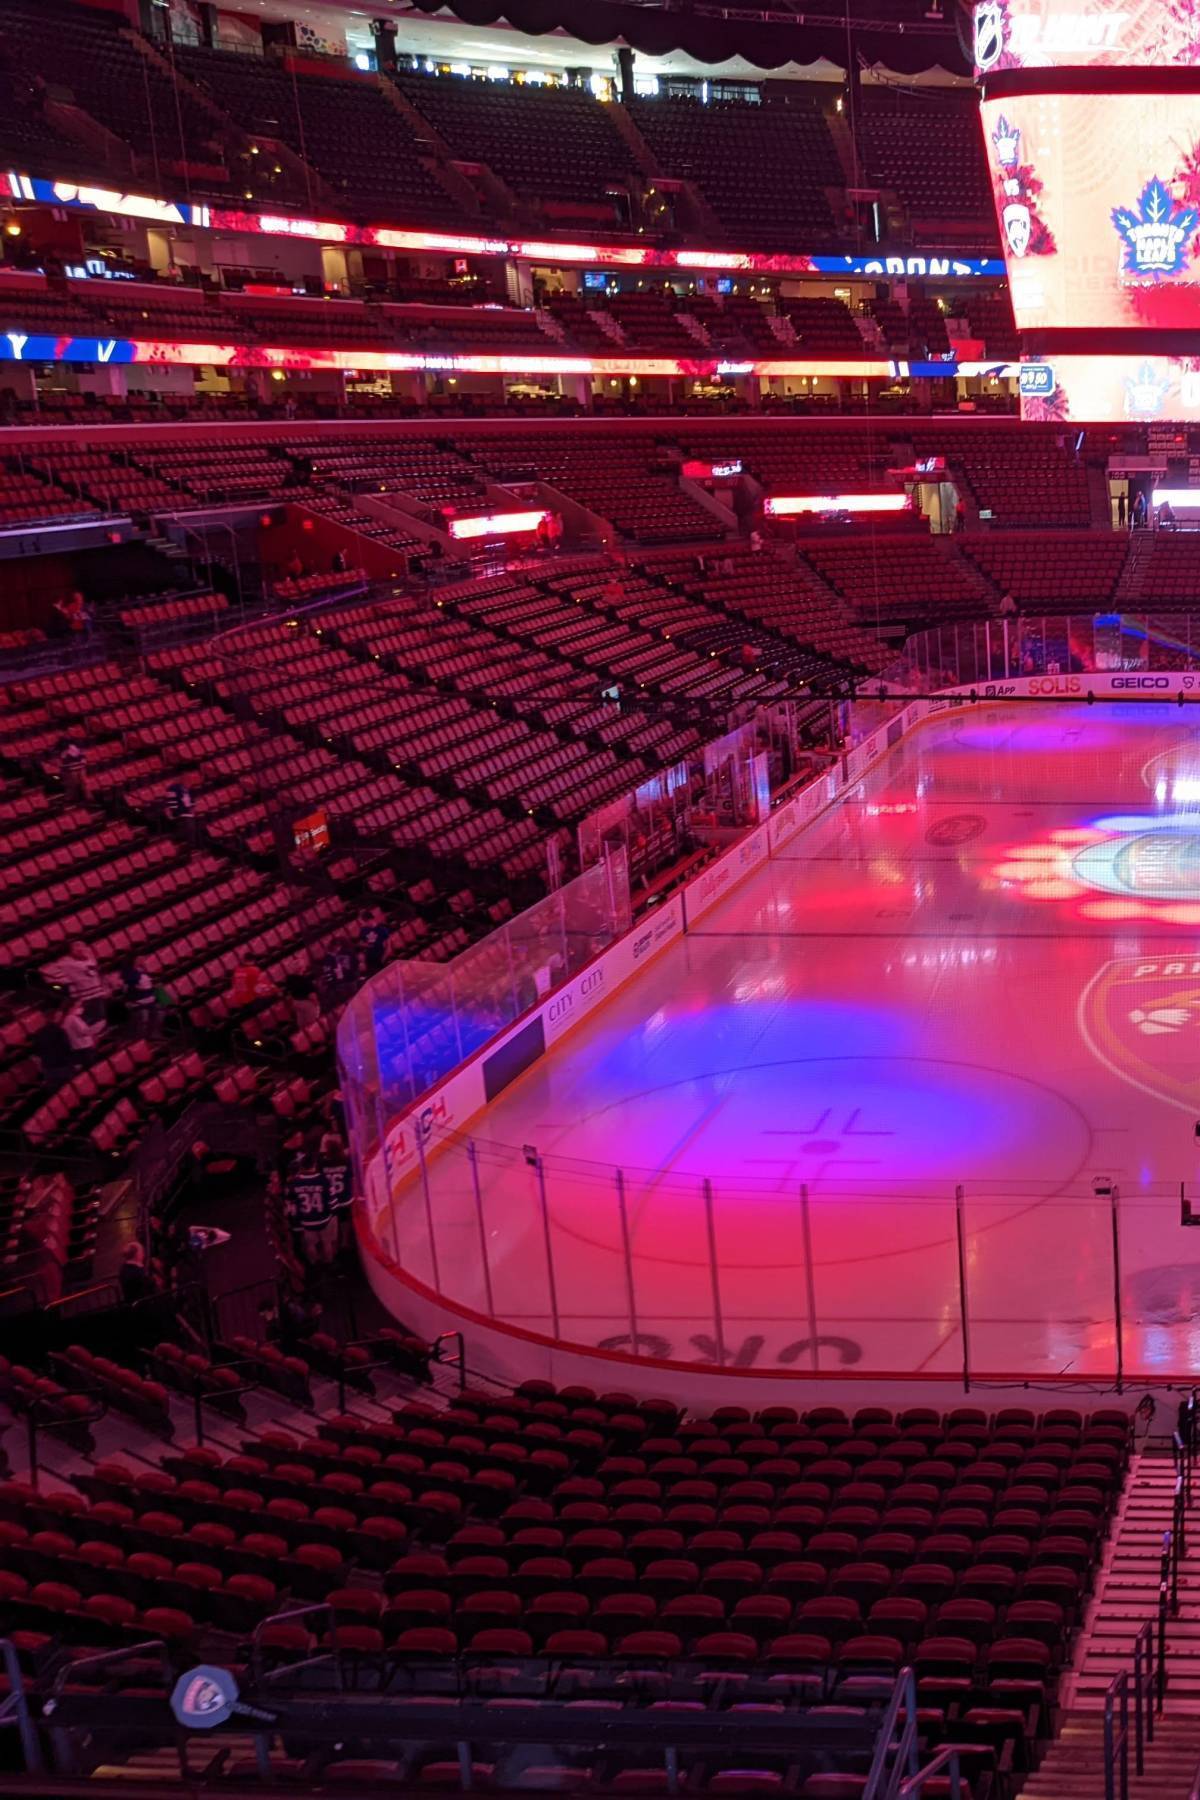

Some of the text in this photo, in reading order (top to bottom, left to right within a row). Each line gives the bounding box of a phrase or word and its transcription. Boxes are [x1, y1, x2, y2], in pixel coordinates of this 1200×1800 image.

[1028, 676, 1081, 695] SOLIS
[1111, 677, 1170, 689] GEICO
[549, 991, 574, 1021] CITY
[299, 1193, 323, 1213] 34
